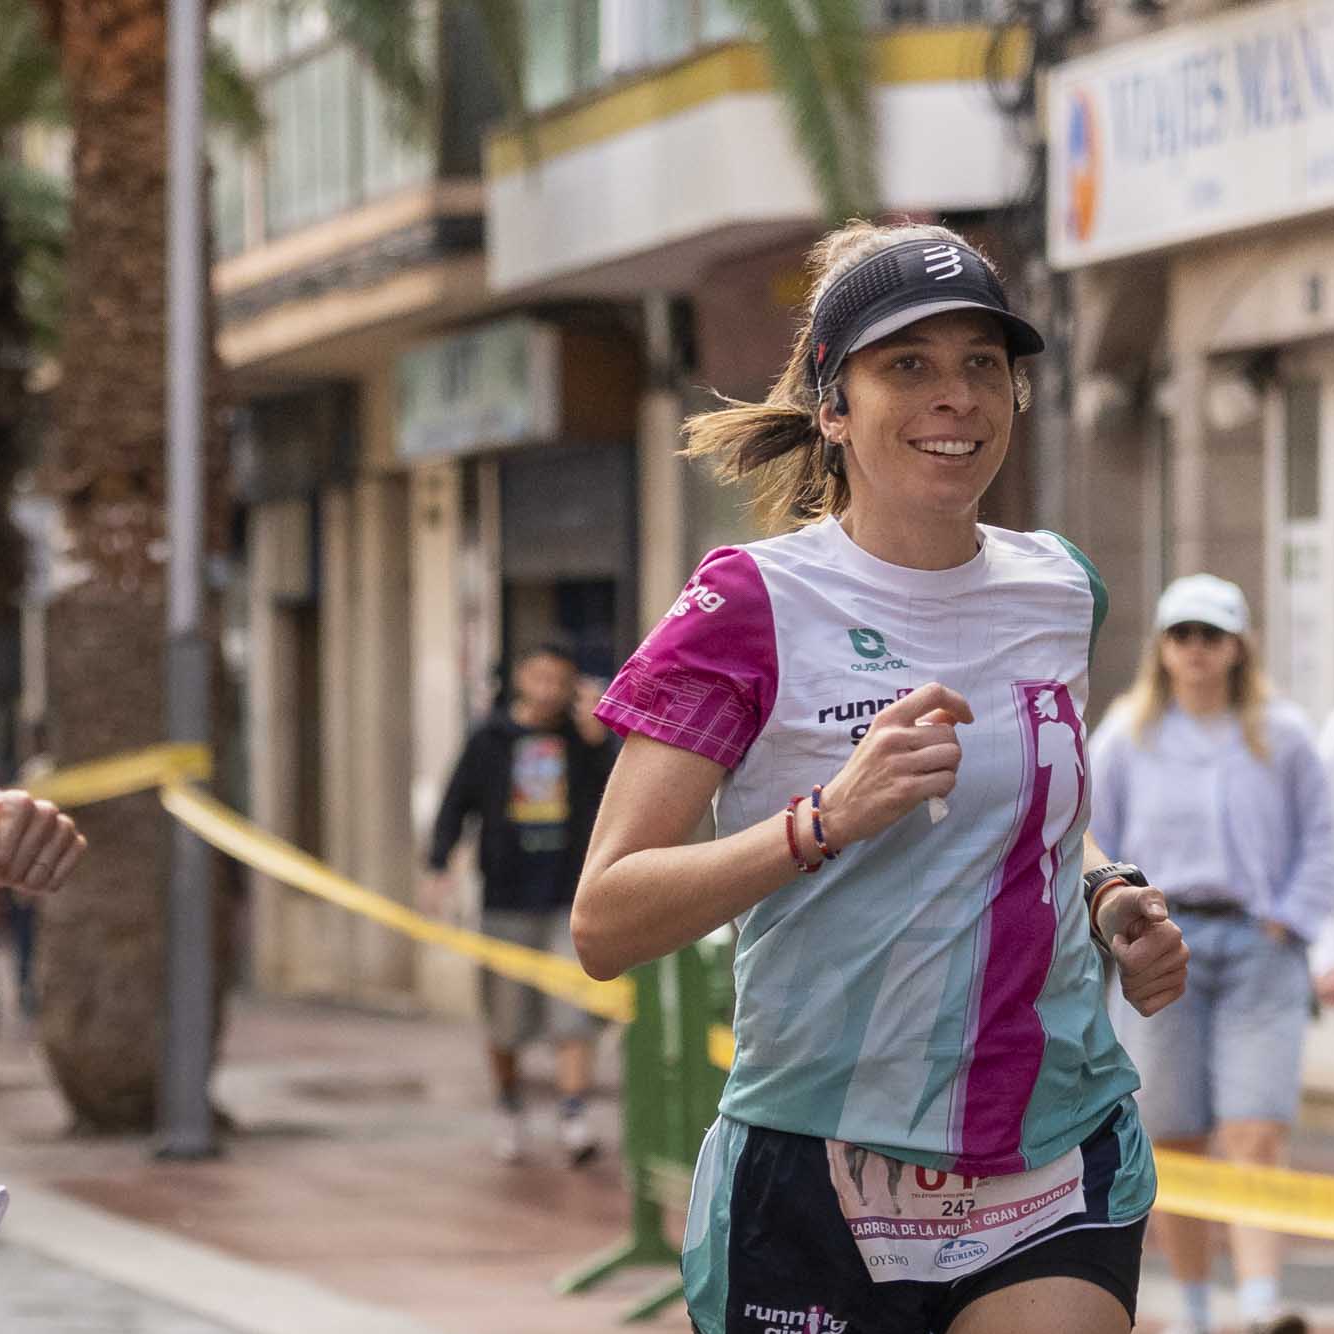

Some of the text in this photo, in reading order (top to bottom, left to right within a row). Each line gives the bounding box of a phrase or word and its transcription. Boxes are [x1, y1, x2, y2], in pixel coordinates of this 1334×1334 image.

[851, 1220, 898, 1236] CARRERA
[902, 1223, 917, 1236] DE
[918, 1224, 934, 1237] LA
[983, 1209, 1018, 1227] GRAN
[1020, 1184, 1073, 1215] CANARIA
[869, 1254, 909, 1267] OYSHO
[937, 1245, 986, 1266] ASTURIANA
